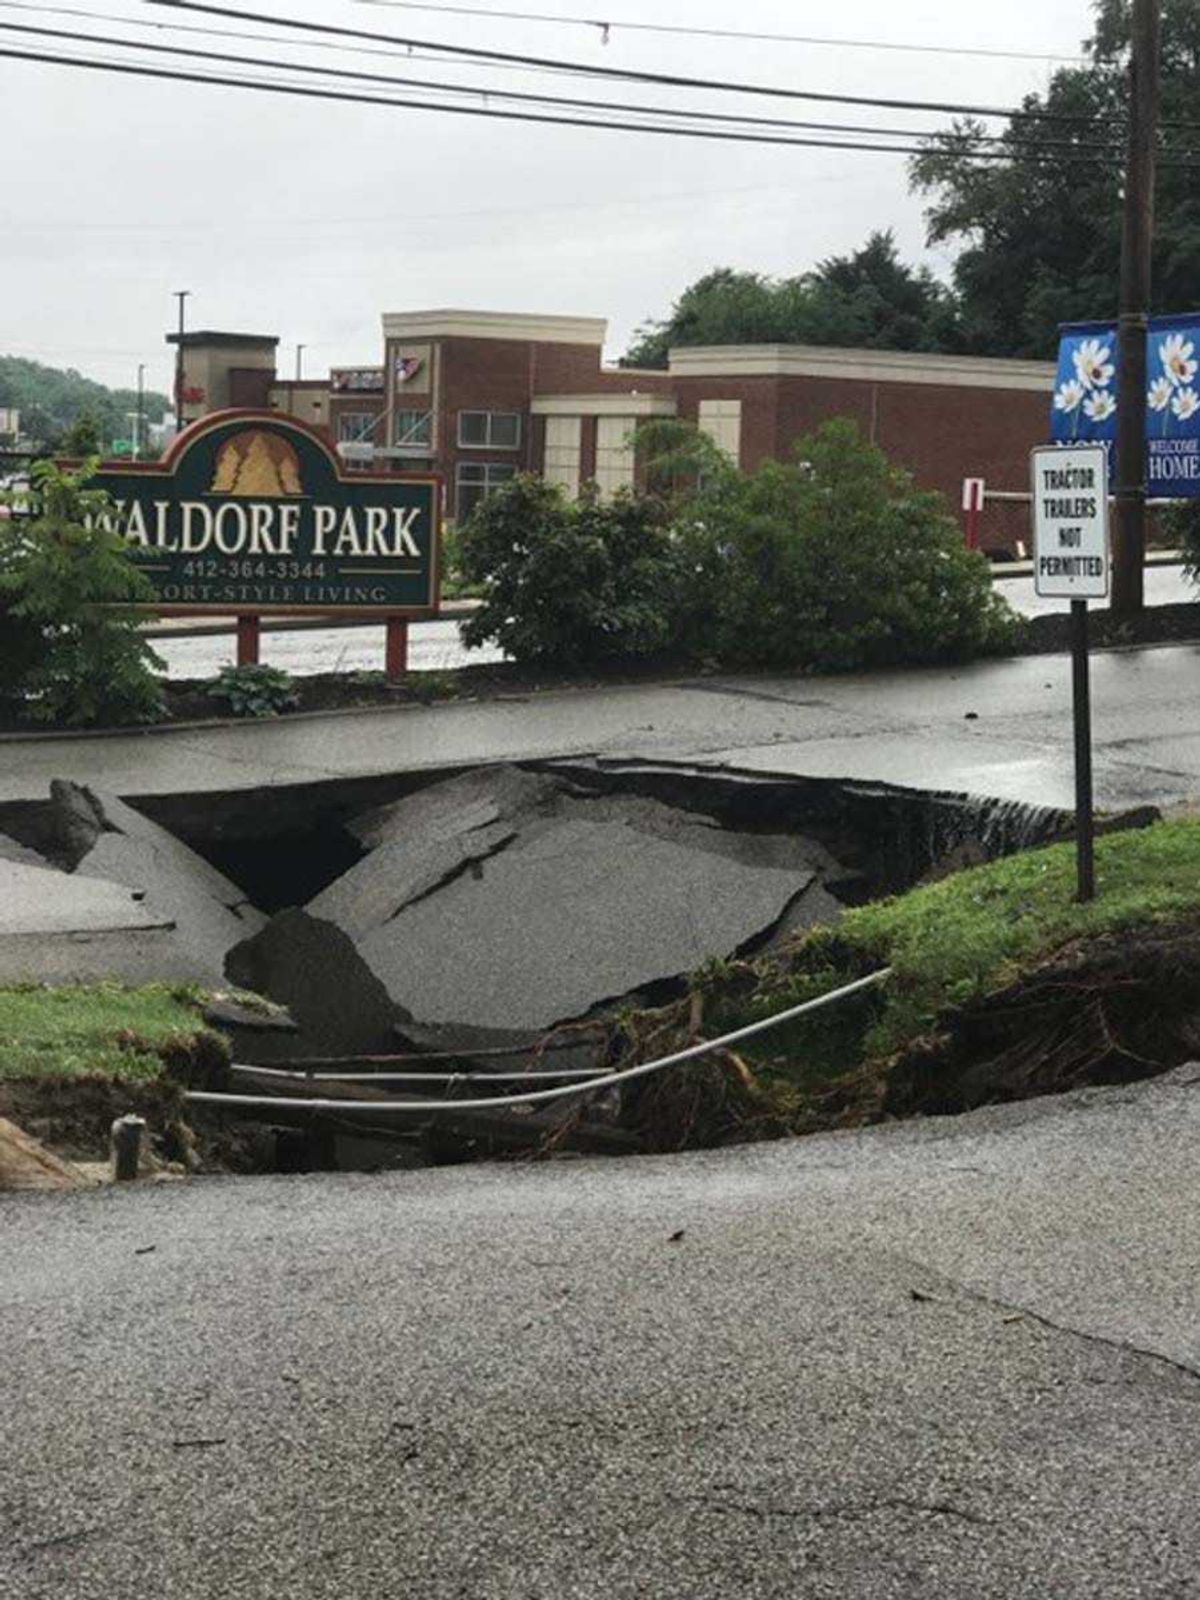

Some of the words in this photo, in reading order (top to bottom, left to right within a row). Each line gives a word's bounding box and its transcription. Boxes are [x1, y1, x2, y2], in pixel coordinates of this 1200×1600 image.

[1149, 455, 1200, 479] HOME
[1043, 467, 1094, 490] TRACTOR
[1043, 497, 1096, 519] TRAILERS
[311, 505, 421, 557] PARK
[1059, 527, 1081, 548] NOT
[183, 560, 326, 579] 412-364-3344
[1040, 555, 1103, 577] PERMITTED
[305, 586, 387, 602] LIVING
